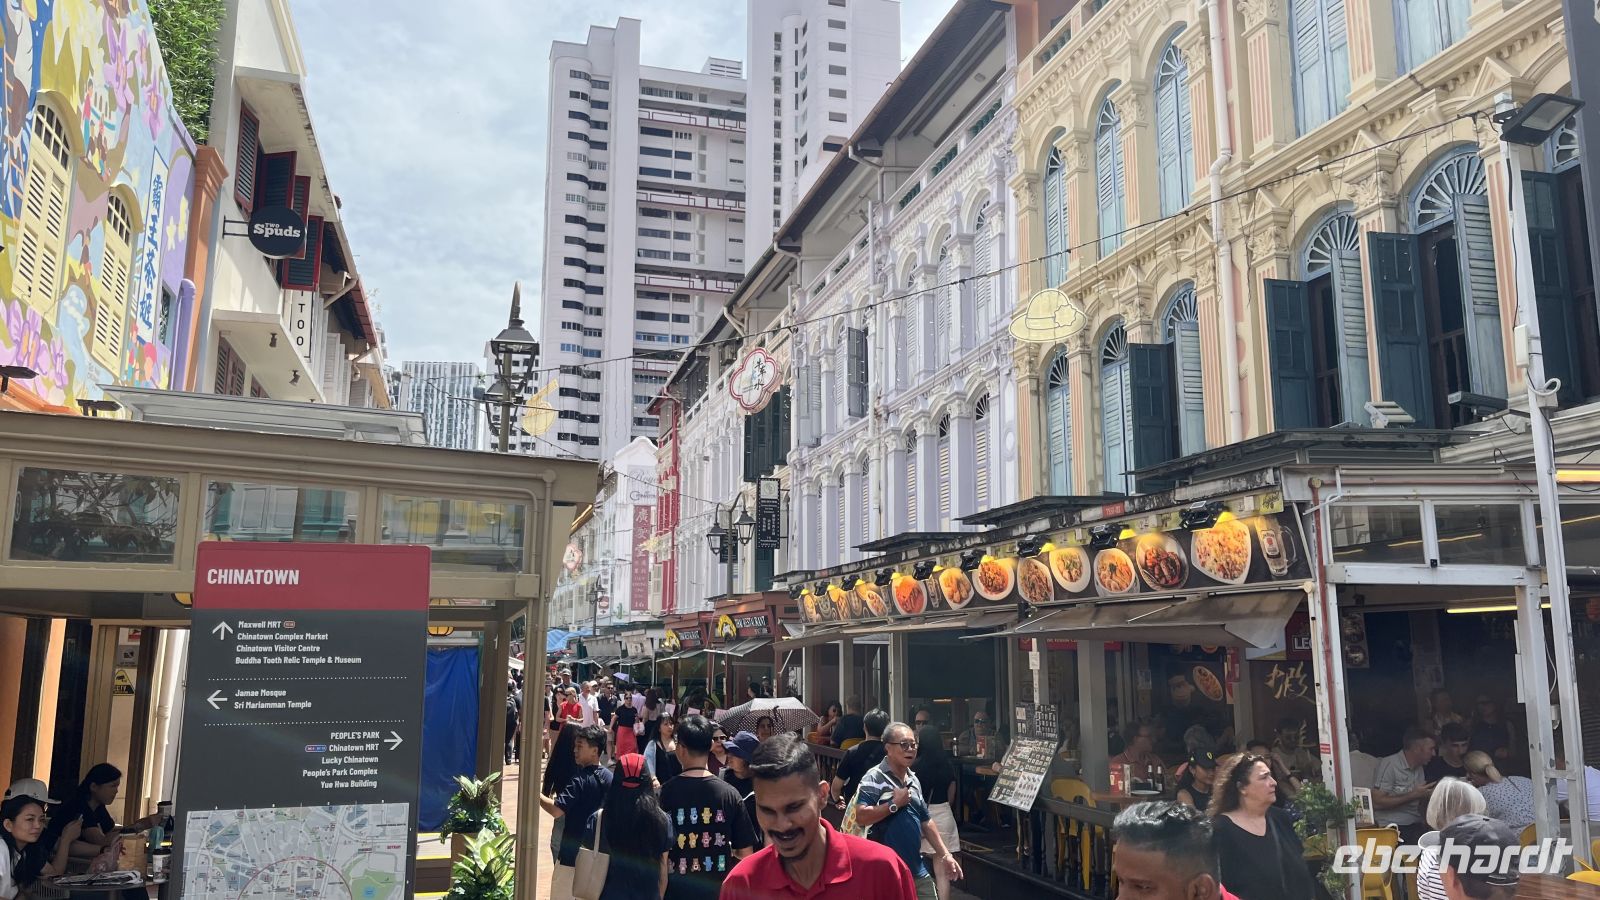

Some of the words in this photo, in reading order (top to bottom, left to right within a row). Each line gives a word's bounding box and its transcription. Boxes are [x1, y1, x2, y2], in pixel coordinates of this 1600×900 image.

[253, 223, 300, 238] Spuds
[207, 569, 300, 585] CHINATOWN
[275, 633, 304, 641] Complex
[302, 657, 326, 666] Temple
[260, 689, 287, 698] Mosque
[234, 701, 244, 709] Sri
[246, 701, 286, 709] Mariamman
[287, 701, 312, 709] Temple
[329, 744, 364, 752] Chinatown
[365, 744, 379, 752] MRT
[322, 757, 342, 765] Lucky
[302, 769, 331, 778] People's
[349, 769, 378, 777] Complex
[350, 780, 377, 789] Building
